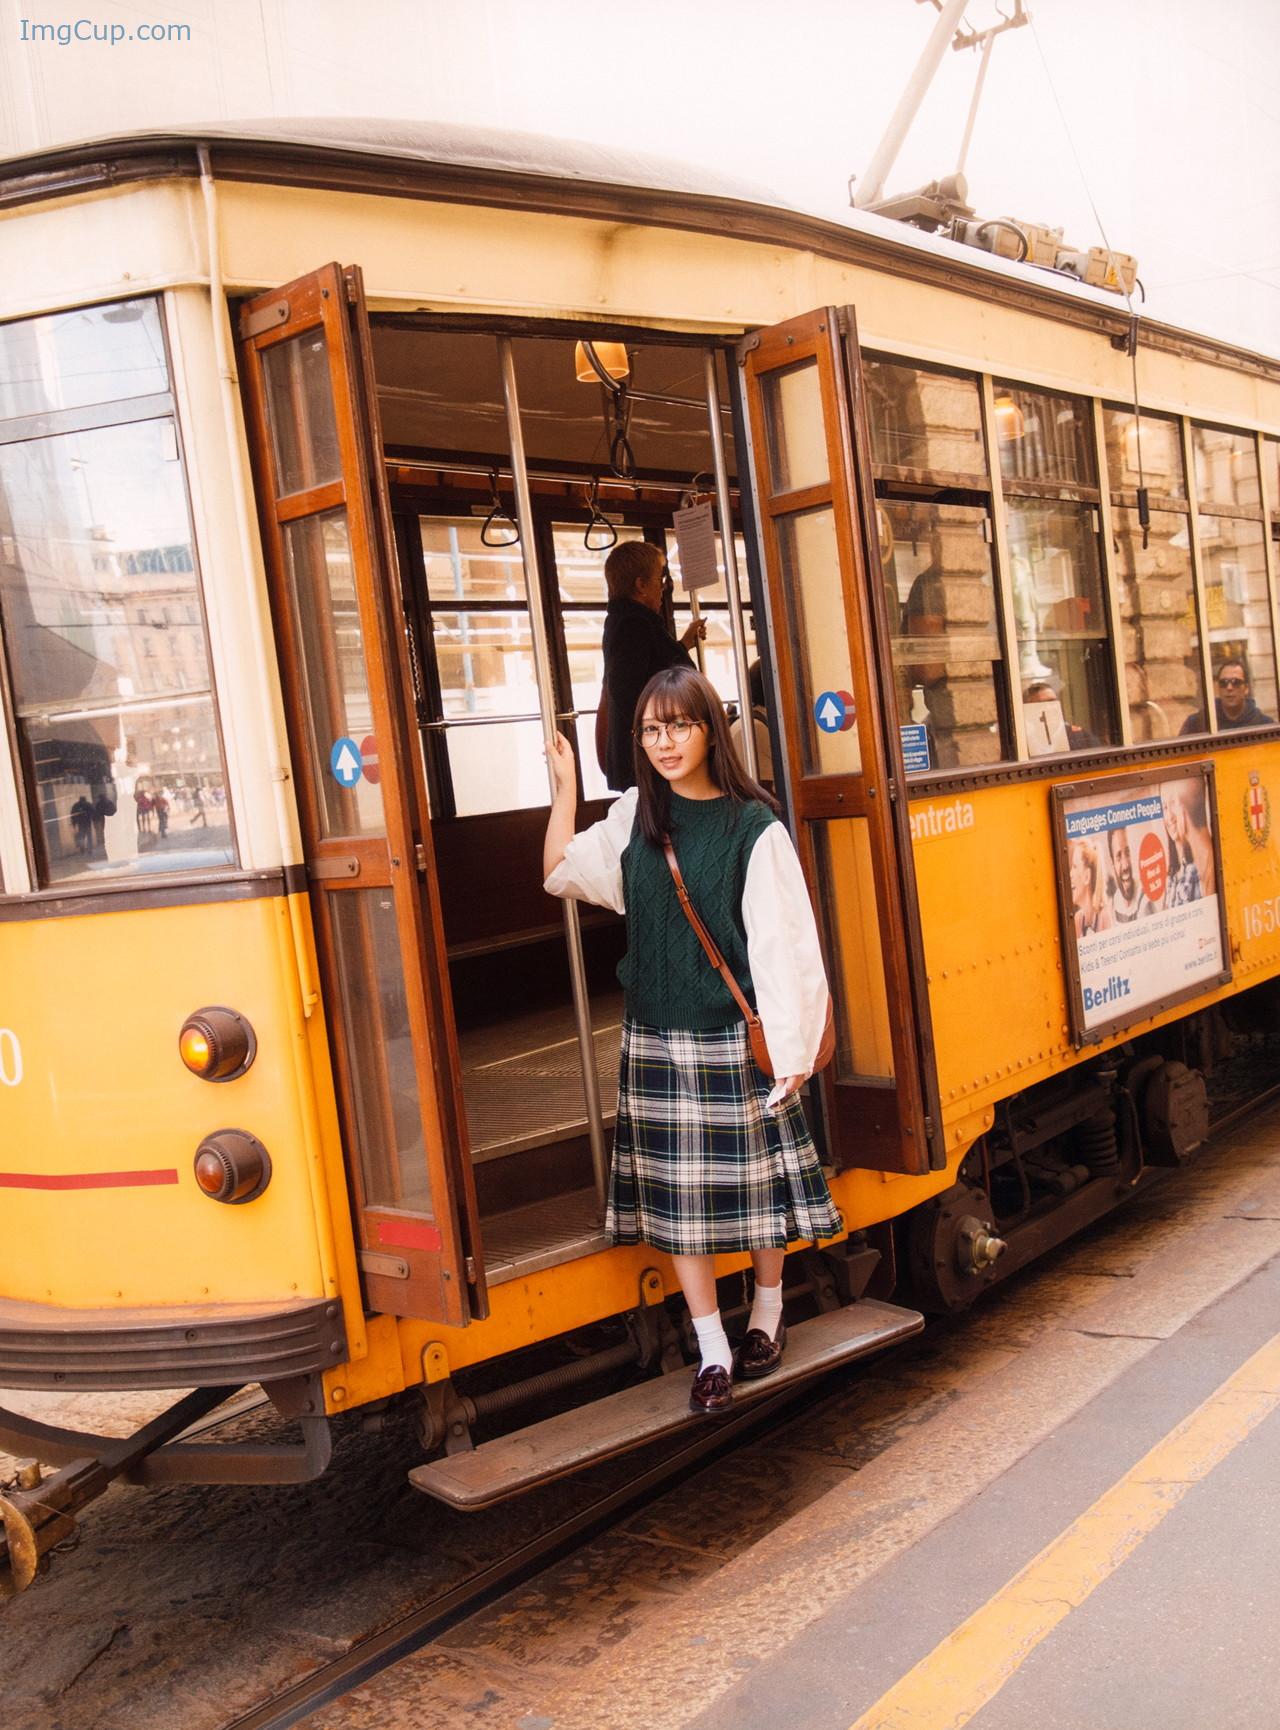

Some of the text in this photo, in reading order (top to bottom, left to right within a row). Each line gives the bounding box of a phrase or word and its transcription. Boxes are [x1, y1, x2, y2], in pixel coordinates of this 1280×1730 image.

[1039, 711, 1052, 745] 1
[1065, 800, 1160, 834] Languages Connect People
[1095, 958, 1100, 969] &
[1083, 976, 1130, 1011] Berlitz
[0, 1027, 23, 1086] 0
